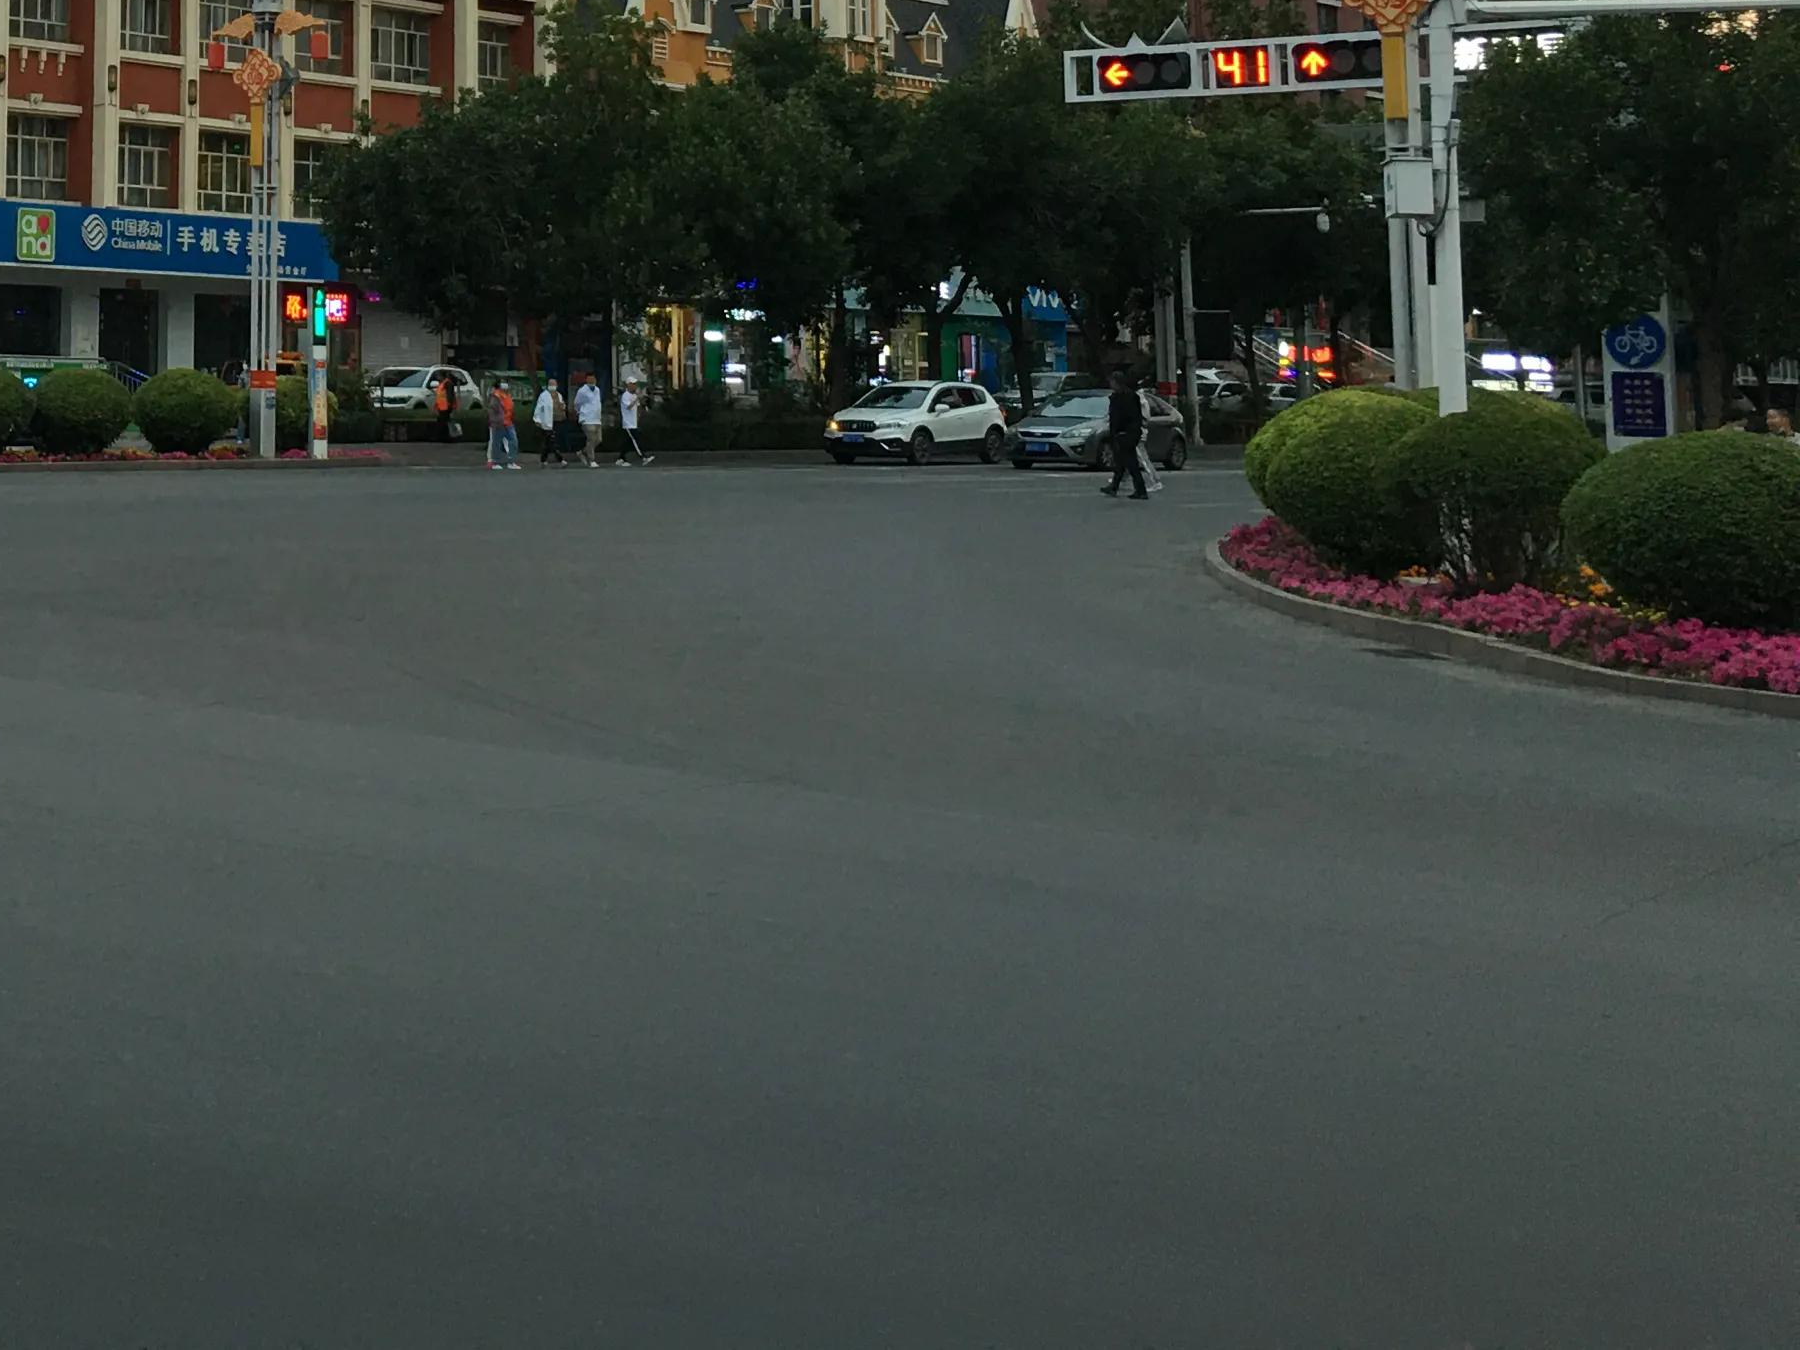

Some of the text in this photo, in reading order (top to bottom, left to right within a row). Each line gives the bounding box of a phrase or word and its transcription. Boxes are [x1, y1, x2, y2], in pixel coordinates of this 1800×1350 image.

[1217, 50, 1266, 84] 41
[111, 217, 163, 238] 中国移动
